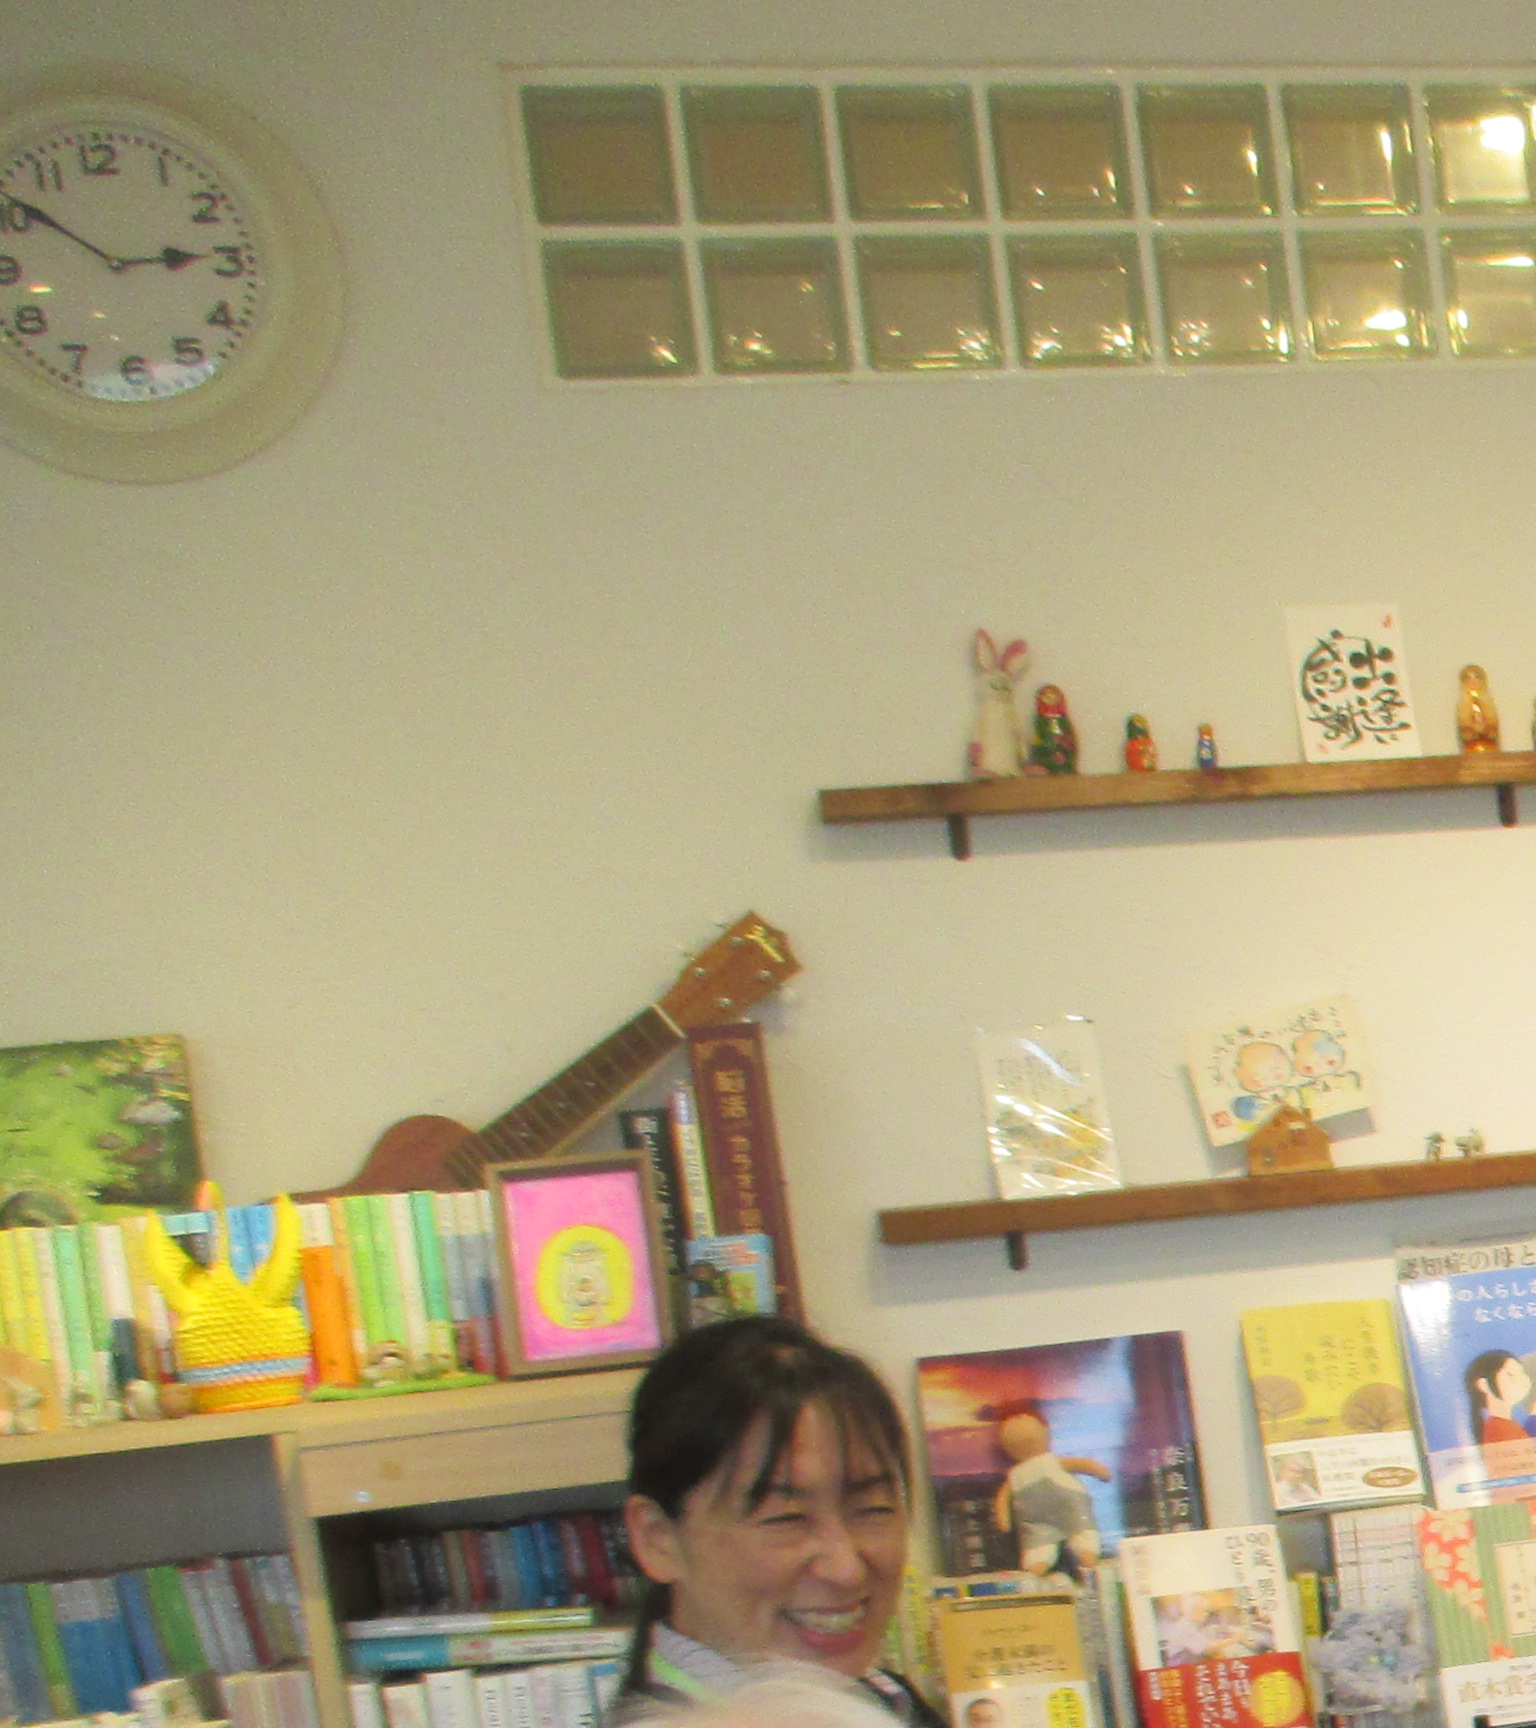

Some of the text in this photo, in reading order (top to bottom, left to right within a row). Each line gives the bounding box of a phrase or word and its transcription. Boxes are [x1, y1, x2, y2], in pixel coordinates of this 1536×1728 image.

[80, 145, 119, 175] 12
[157, 156, 170, 187] 1
[34, 161, 64, 191] 11
[192, 193, 220, 224] 2
[0, 256, 21, 283] 9
[214, 246, 244, 277] 3
[15, 306, 47, 335] 8
[207, 300, 233, 328] 4
[64, 344, 89, 375] 7
[175, 338, 202, 365] 5
[122, 356, 148, 384] 6
